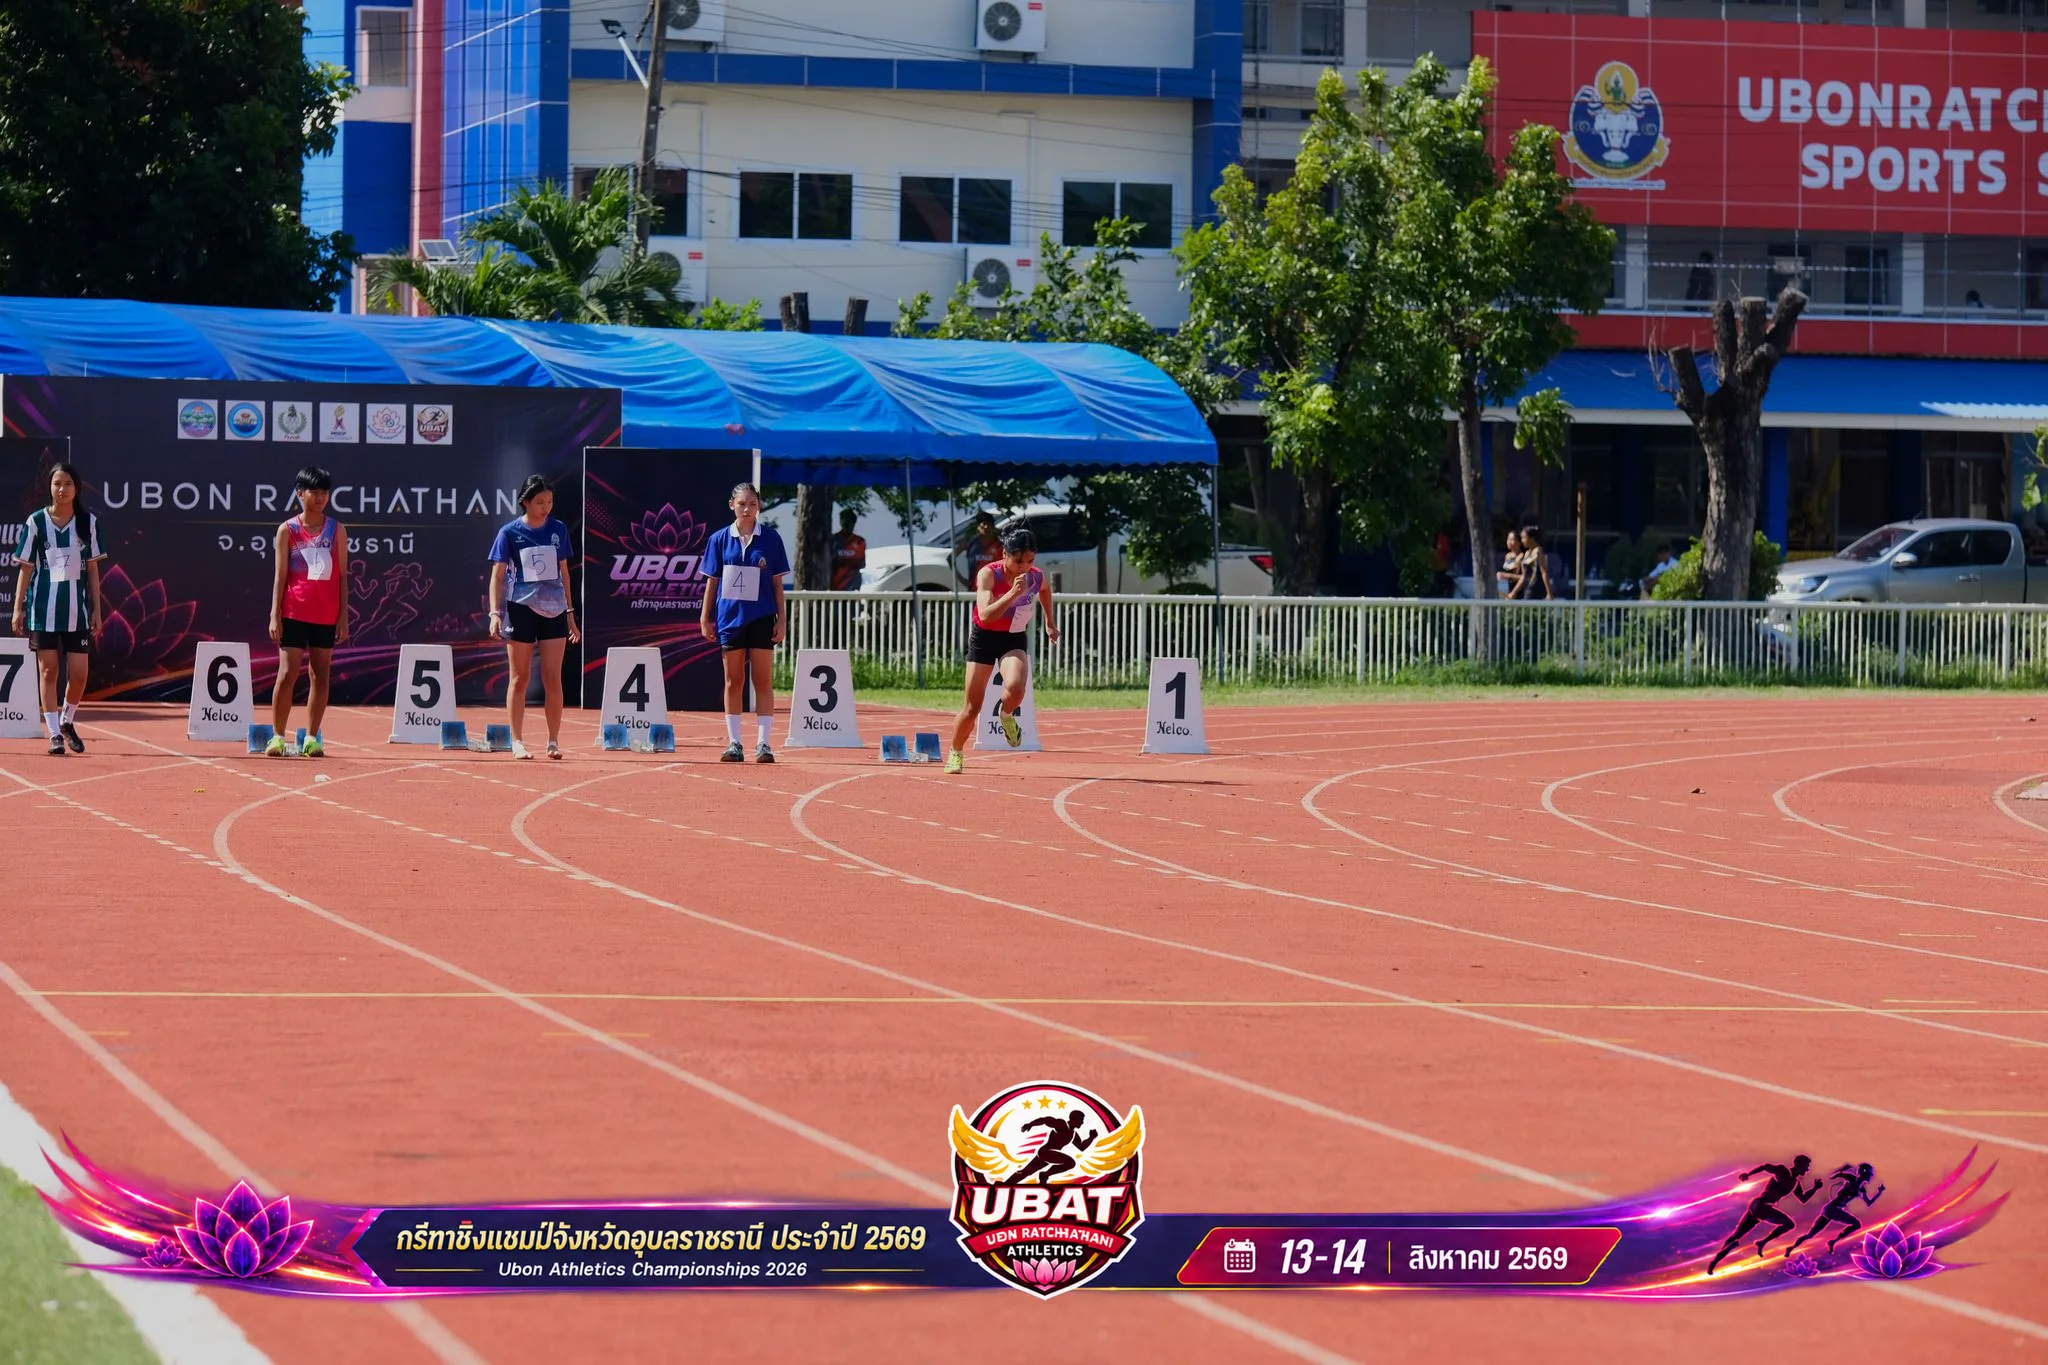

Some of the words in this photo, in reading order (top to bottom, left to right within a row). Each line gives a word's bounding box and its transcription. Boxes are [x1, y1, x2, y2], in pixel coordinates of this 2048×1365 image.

[1801, 143, 2007, 196] SPORTS
[103, 481, 231, 511] UBON
[255, 484, 519, 516] RACHATHAN
[532, 553, 547, 576] 5
[612, 583, 707, 596] ATHLETIC
[732, 571, 747, 594] 4
[0, 654, 24, 703] 7
[207, 655, 239, 704] 6
[410, 661, 441, 709] 5
[620, 664, 650, 712] 4
[808, 665, 838, 713] 3
[1166, 672, 1187, 719] 1
[0, 707, 24, 721] elco
[201, 707, 239, 722] Nelco
[405, 712, 441, 727] Nelco
[615, 715, 650, 729] Nelco
[803, 716, 839, 731] Nelco
[1156, 720, 1190, 736] Nelco
